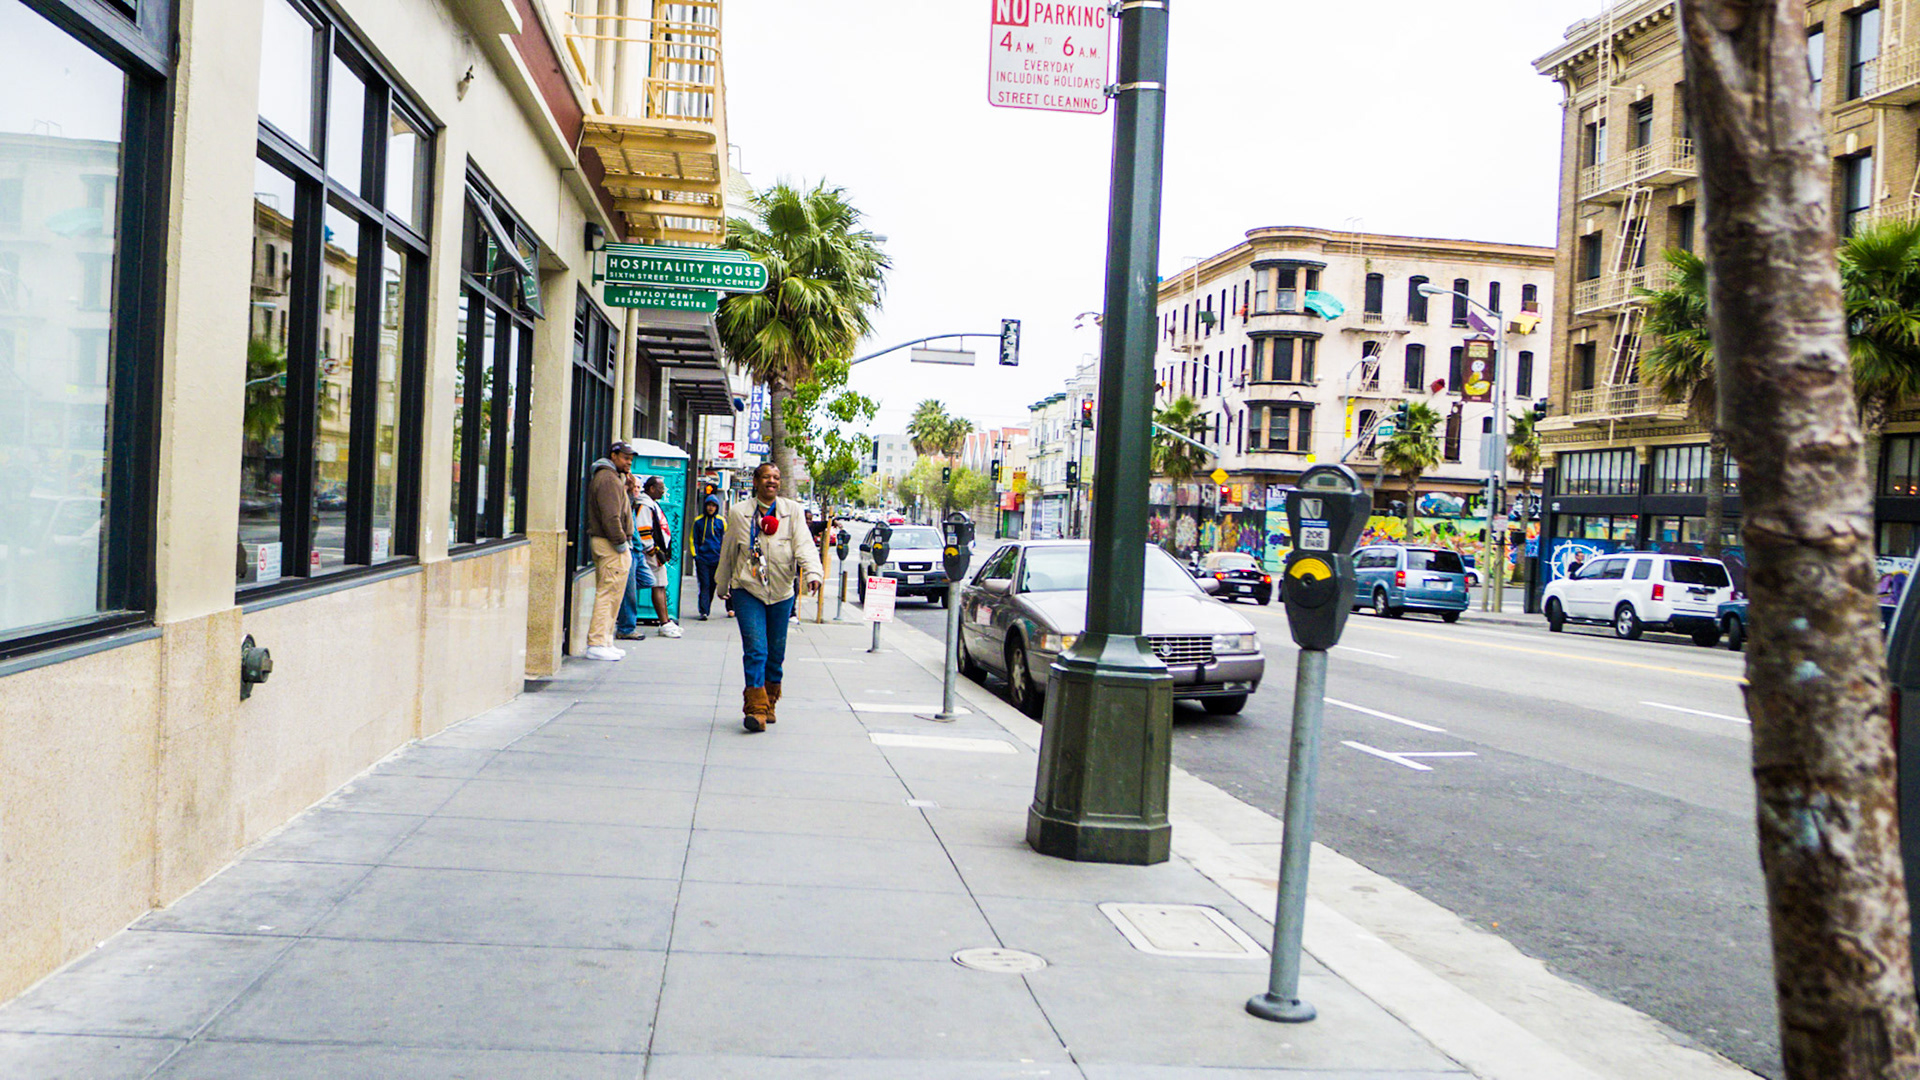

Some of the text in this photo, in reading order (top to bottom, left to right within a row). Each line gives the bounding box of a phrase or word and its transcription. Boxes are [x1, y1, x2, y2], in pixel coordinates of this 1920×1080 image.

[996, 0, 1105, 29] NO PARKING
[999, 31, 1012, 52] 4
[1044, 37, 1052, 45] TO
[1063, 36, 1074, 56] 6
[1079, 47, 1101, 59] A.M.
[1024, 59, 1075, 73] EVERYDAY
[996, 71, 1101, 89] INCLUDING HOLIDAYS
[998, 91, 1098, 109] STREET CLEANING
[609, 258, 761, 278] HOSPITALITY HOUSE
[609, 271, 761, 287] SIXTH STREET SELF-HELP CENTER
[614, 297, 707, 309] RESOURCE CENTER
[628, 290, 694, 300] EMPLOYMENT
[1305, 530, 1324, 540] 206
